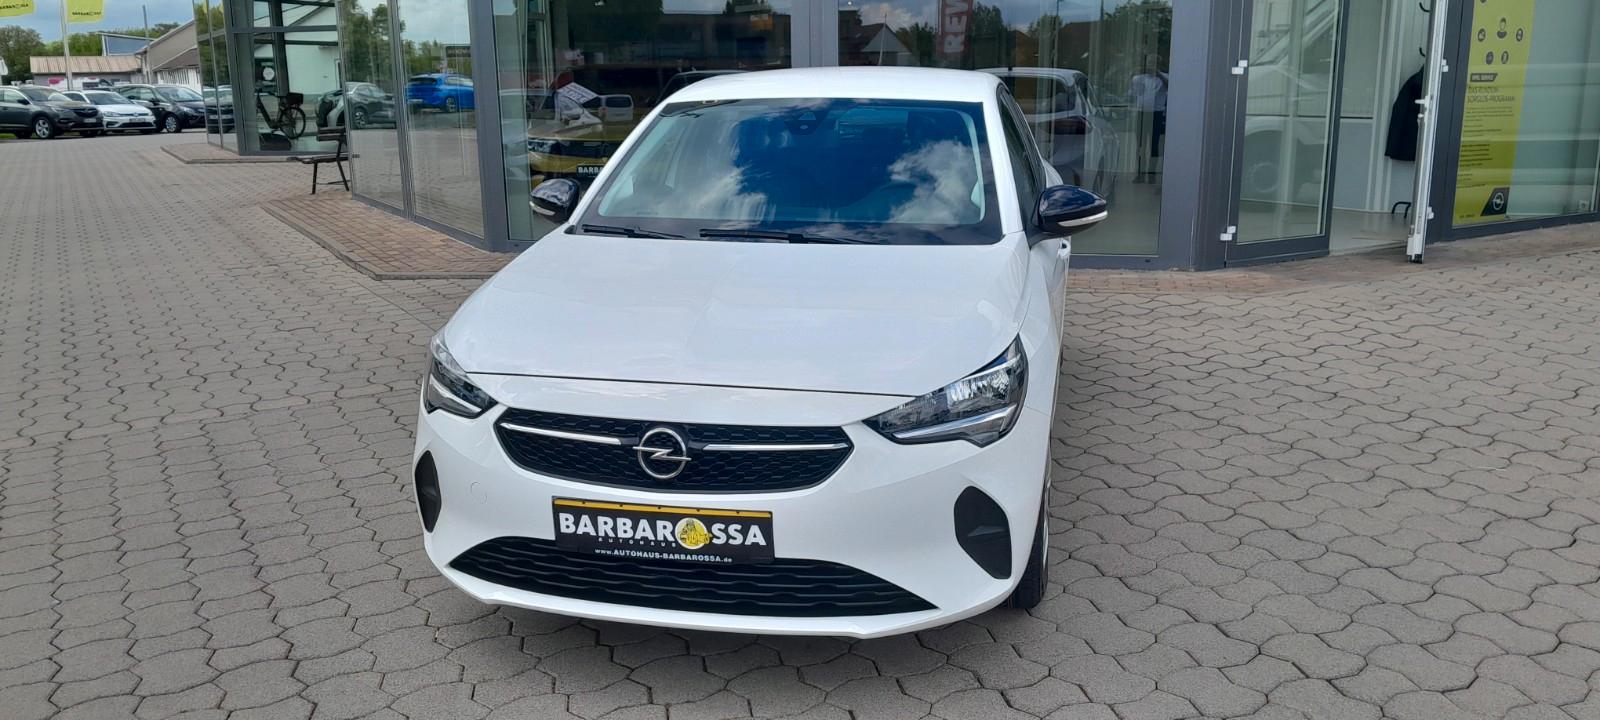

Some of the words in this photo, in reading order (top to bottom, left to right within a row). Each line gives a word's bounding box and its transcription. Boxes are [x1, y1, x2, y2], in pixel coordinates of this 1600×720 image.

[558, 512, 767, 549] BARBAROSSA
[598, 537, 676, 548] AUTOHAUS
[594, 548, 733, 563] www.AUTOHAUS-BARBAROSSA.de
